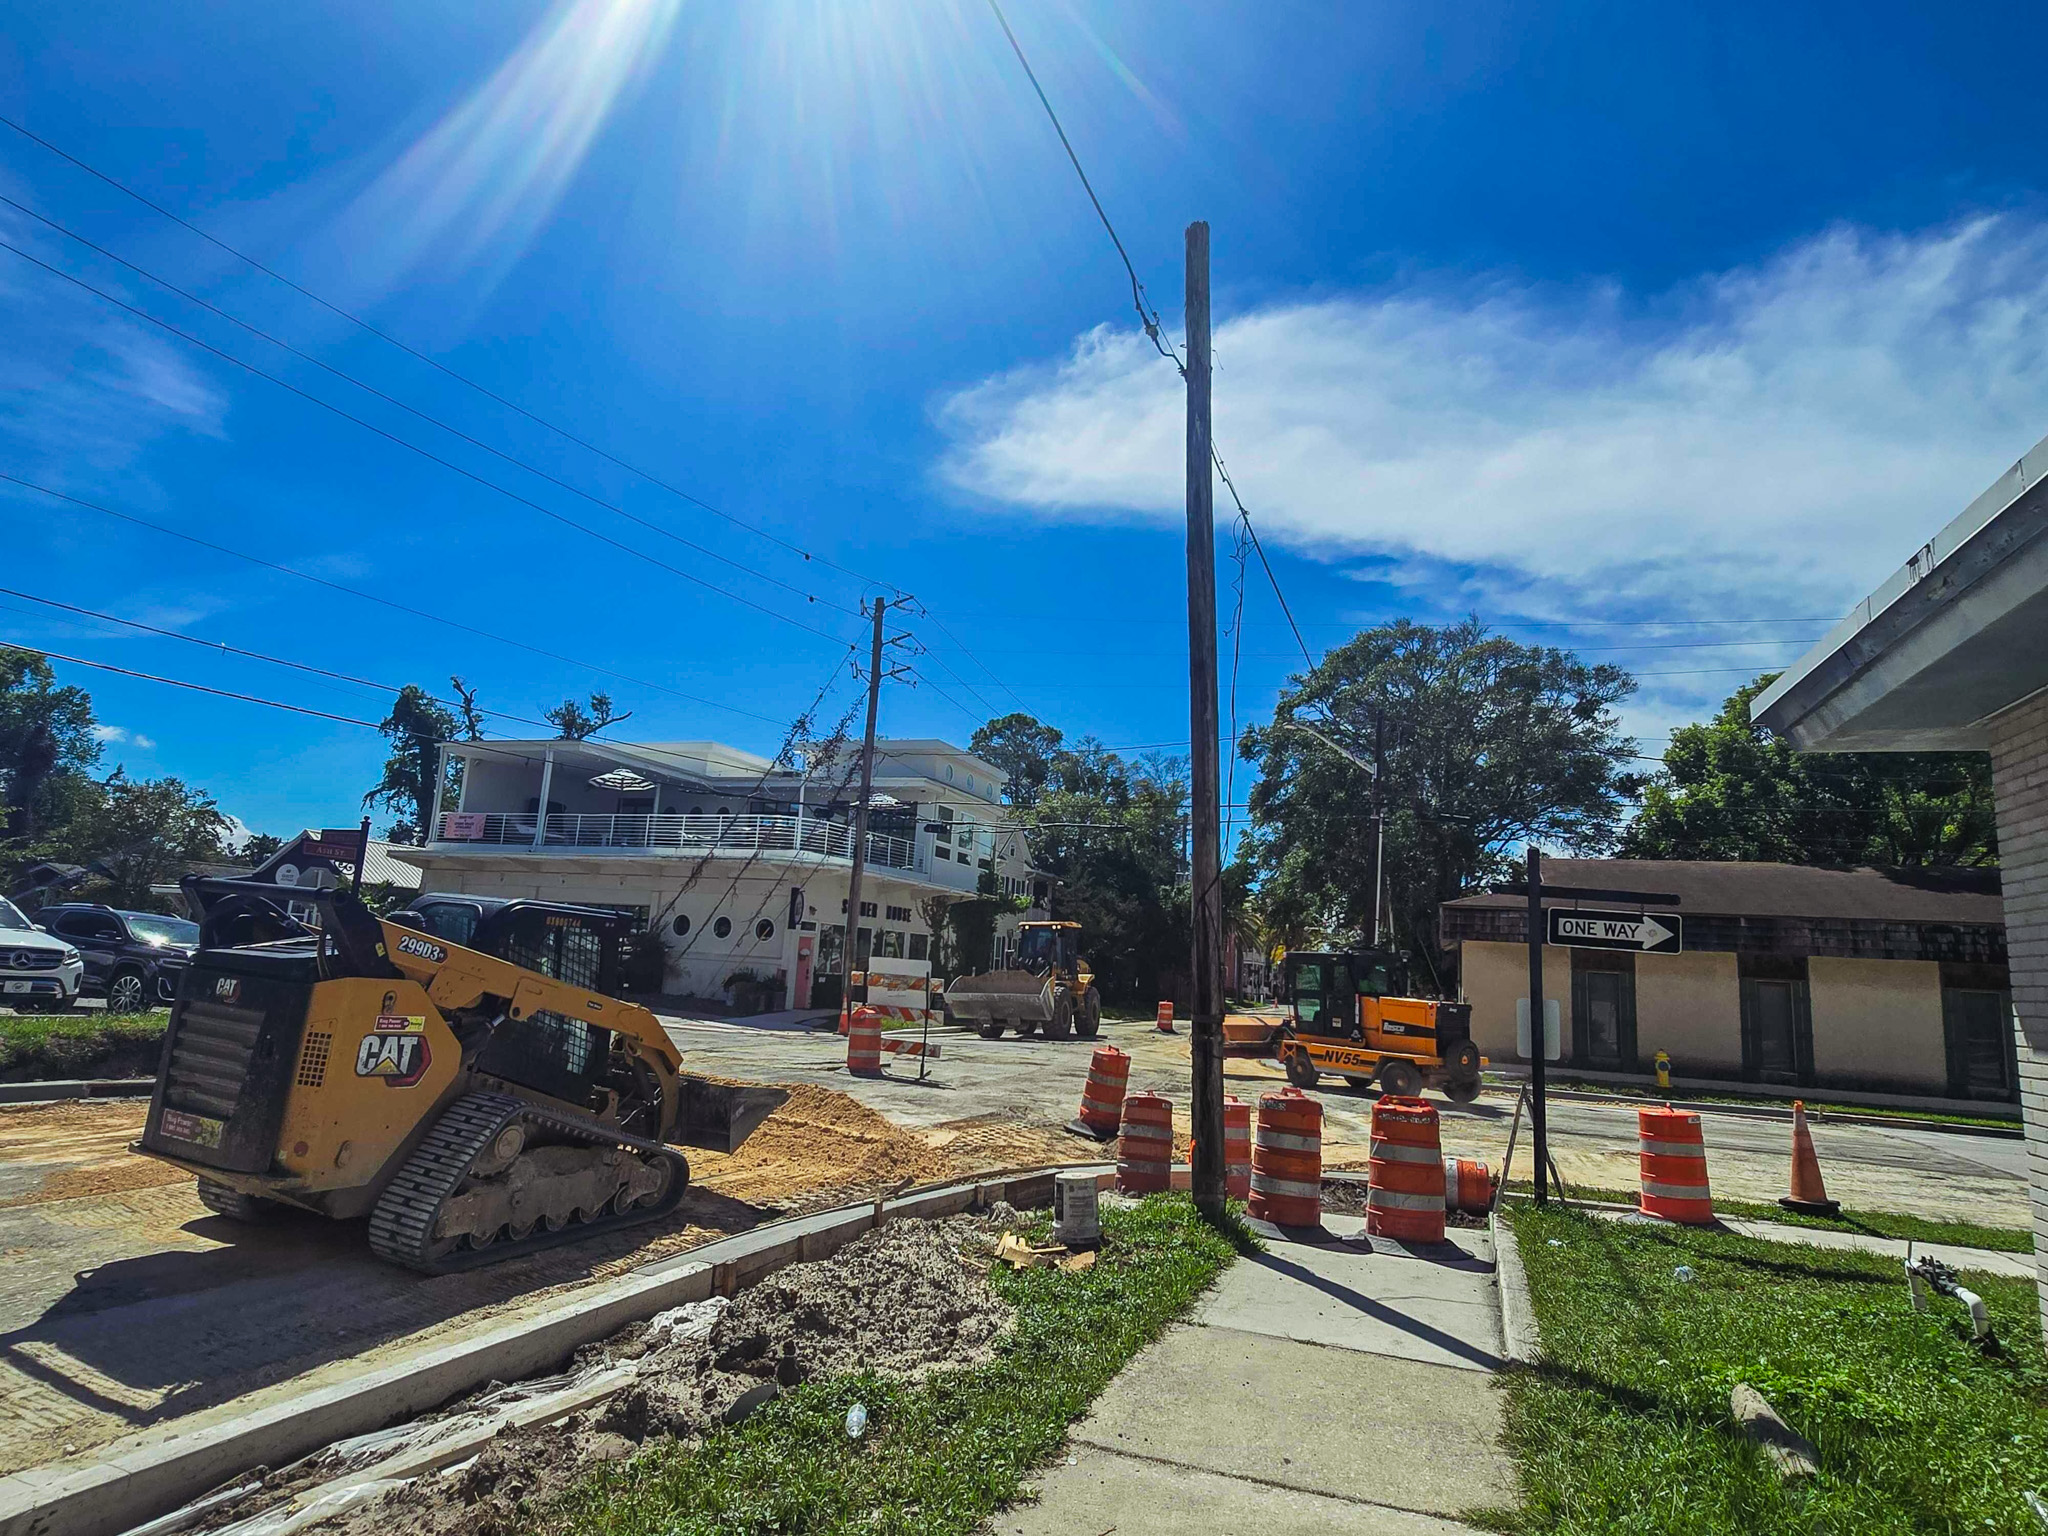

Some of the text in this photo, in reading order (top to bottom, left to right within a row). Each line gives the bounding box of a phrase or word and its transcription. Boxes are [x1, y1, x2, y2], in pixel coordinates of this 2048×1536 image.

[885, 904, 912, 922] HOUSE
[1562, 920, 1640, 939] ONE WAY
[398, 935, 440, 961] 299D3
[215, 977, 238, 996] CAT
[356, 1035, 419, 1075] CAT
[1323, 1049, 1361, 1066] NV55
